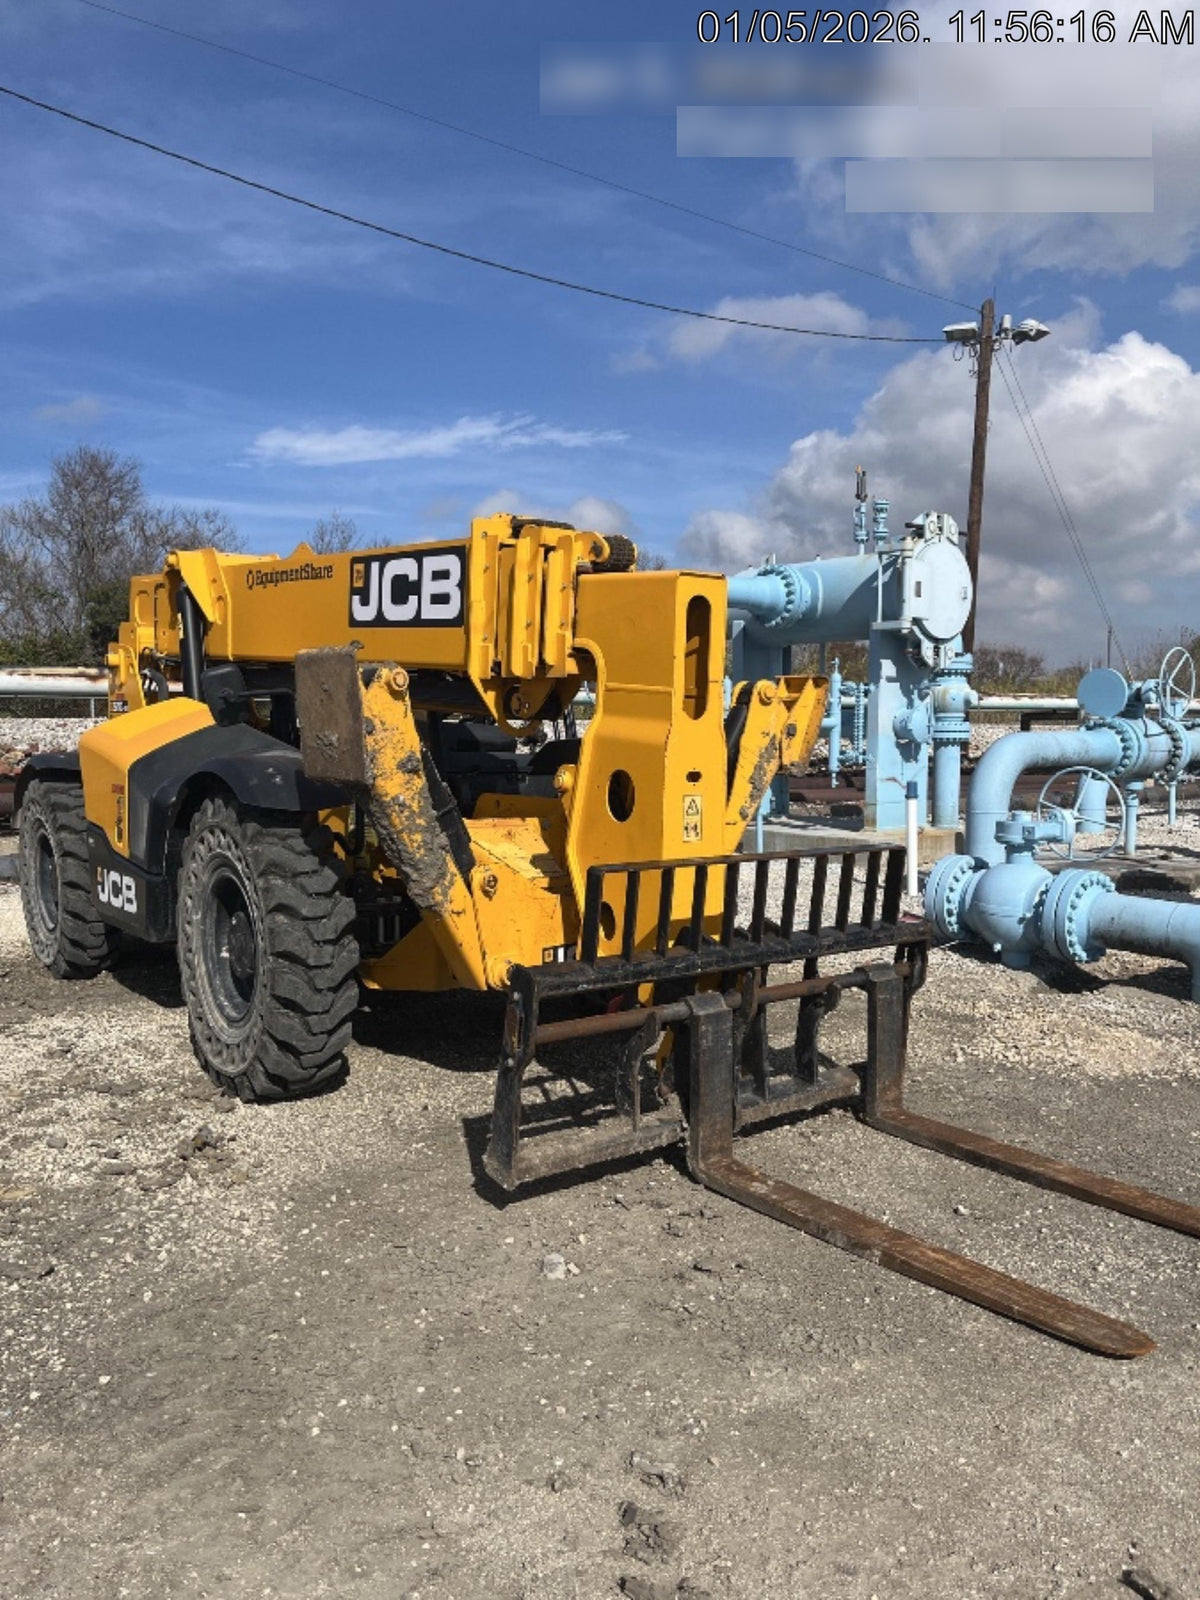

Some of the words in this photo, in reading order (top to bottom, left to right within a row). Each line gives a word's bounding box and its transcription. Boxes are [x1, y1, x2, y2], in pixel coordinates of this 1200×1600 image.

[255, 563, 333, 588] EquipmentShare
[351, 554, 461, 621] JCB
[97, 868, 137, 914] JCB
